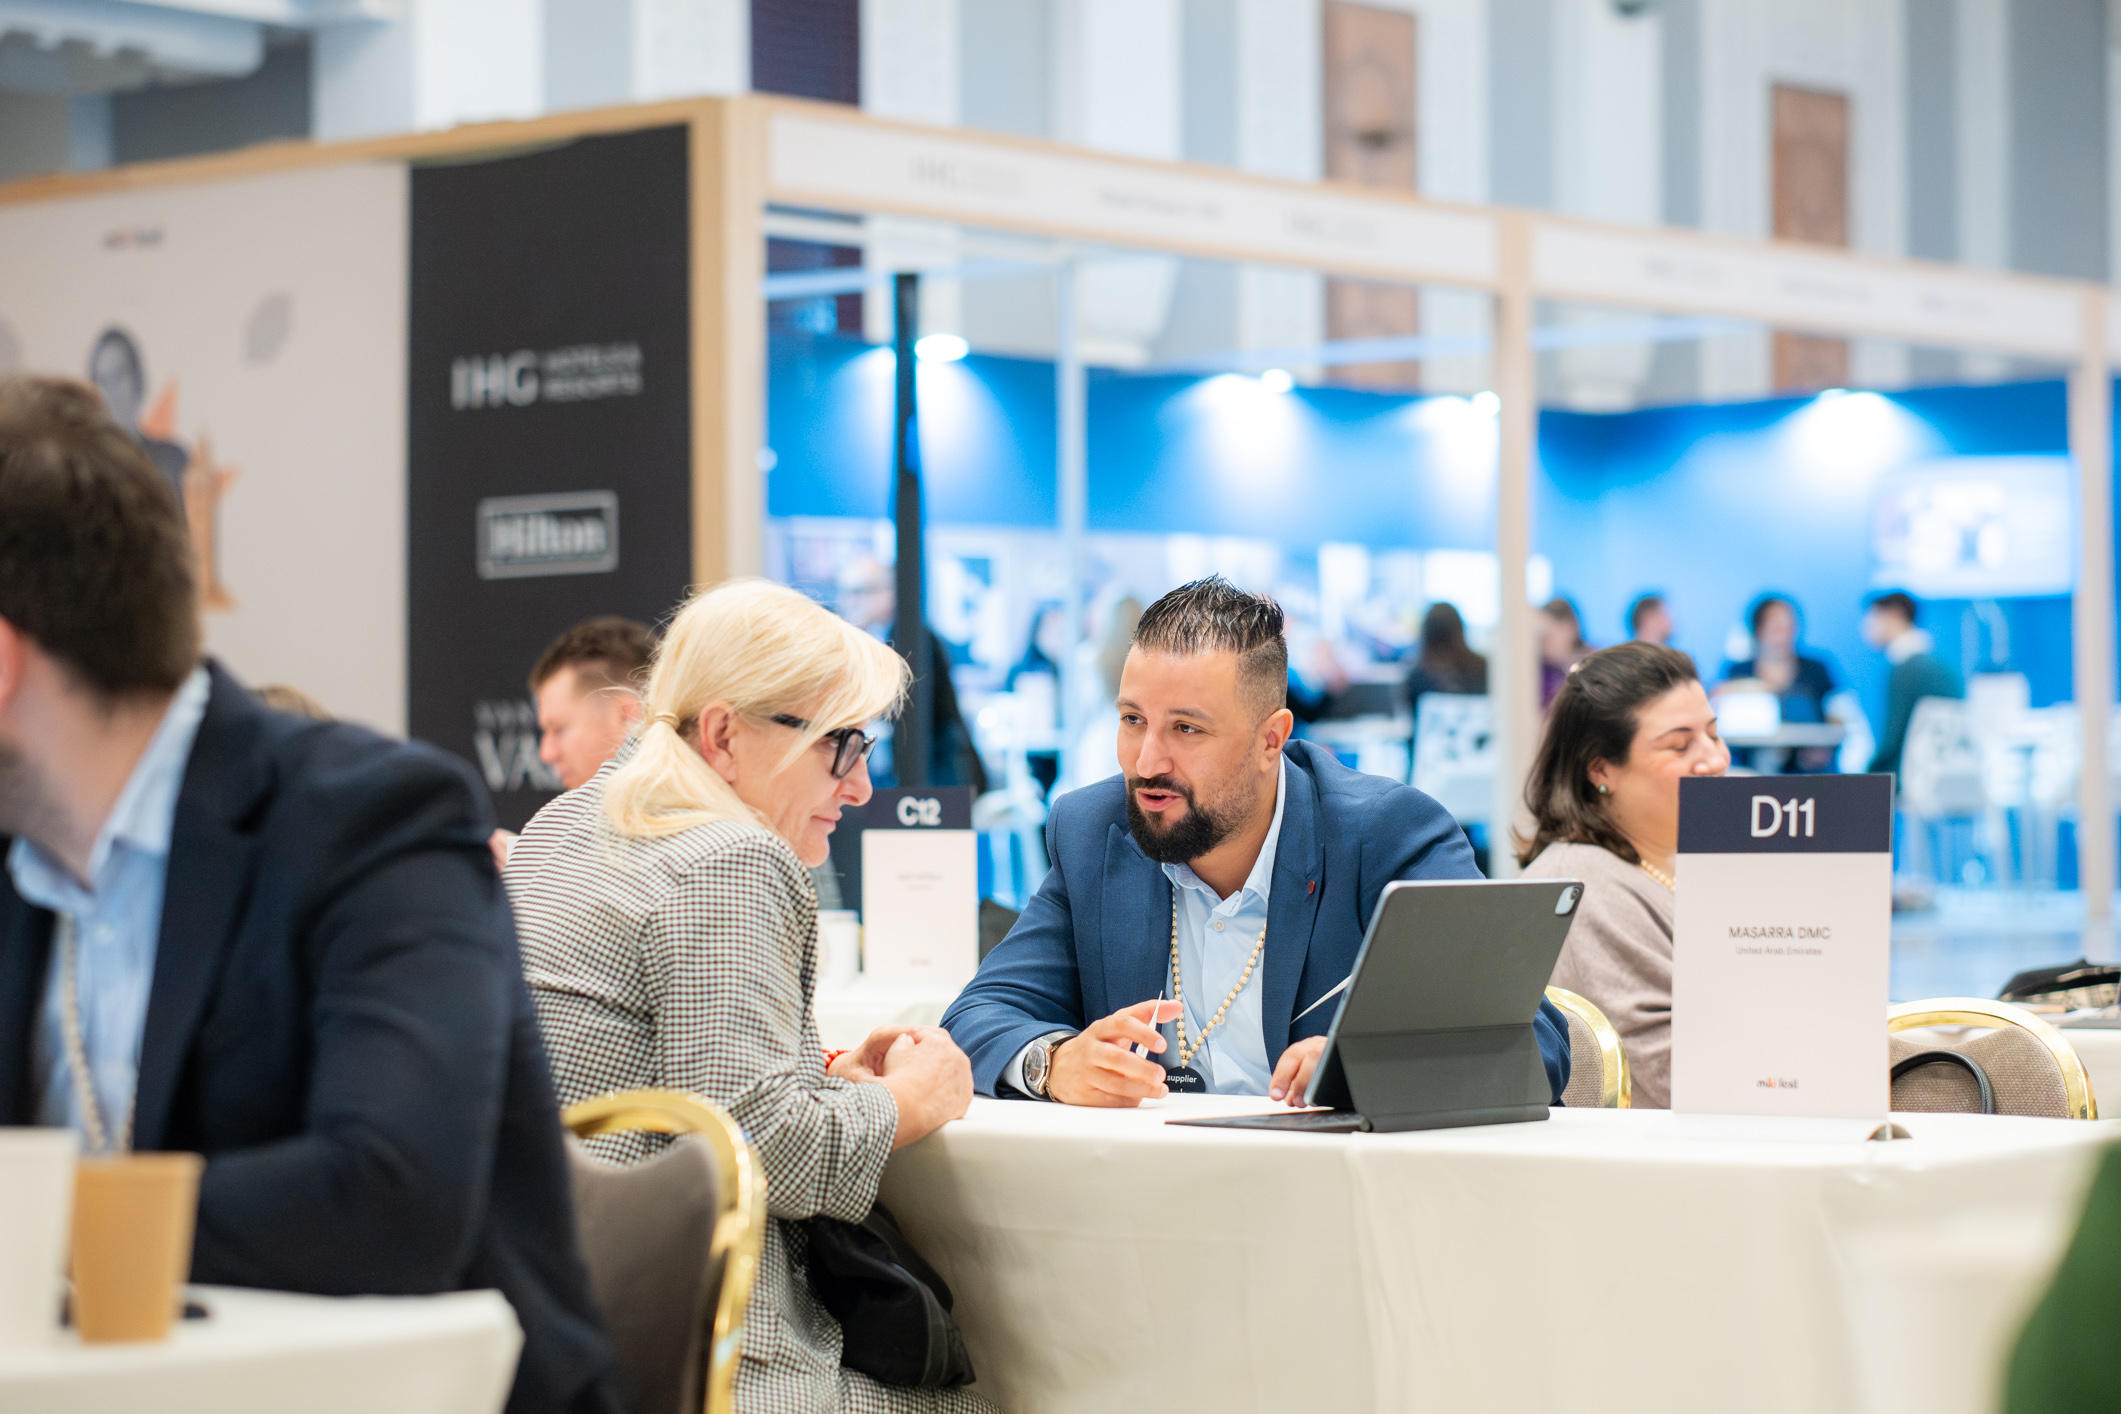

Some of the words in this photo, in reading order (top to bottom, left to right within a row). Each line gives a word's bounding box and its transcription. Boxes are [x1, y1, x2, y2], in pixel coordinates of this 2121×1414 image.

[450, 348, 540, 411] IHG
[487, 511, 607, 559] Hilton
[897, 796, 941, 826] C12
[1751, 795, 1815, 837] D11
[1728, 926, 1793, 939] MASARRA
[1797, 926, 1831, 939] DMC
[1735, 946, 1762, 955] United
[1765, 946, 1783, 955] Arab
[1786, 946, 1822, 956] Emirates
[1166, 1074, 1197, 1083] supplier
